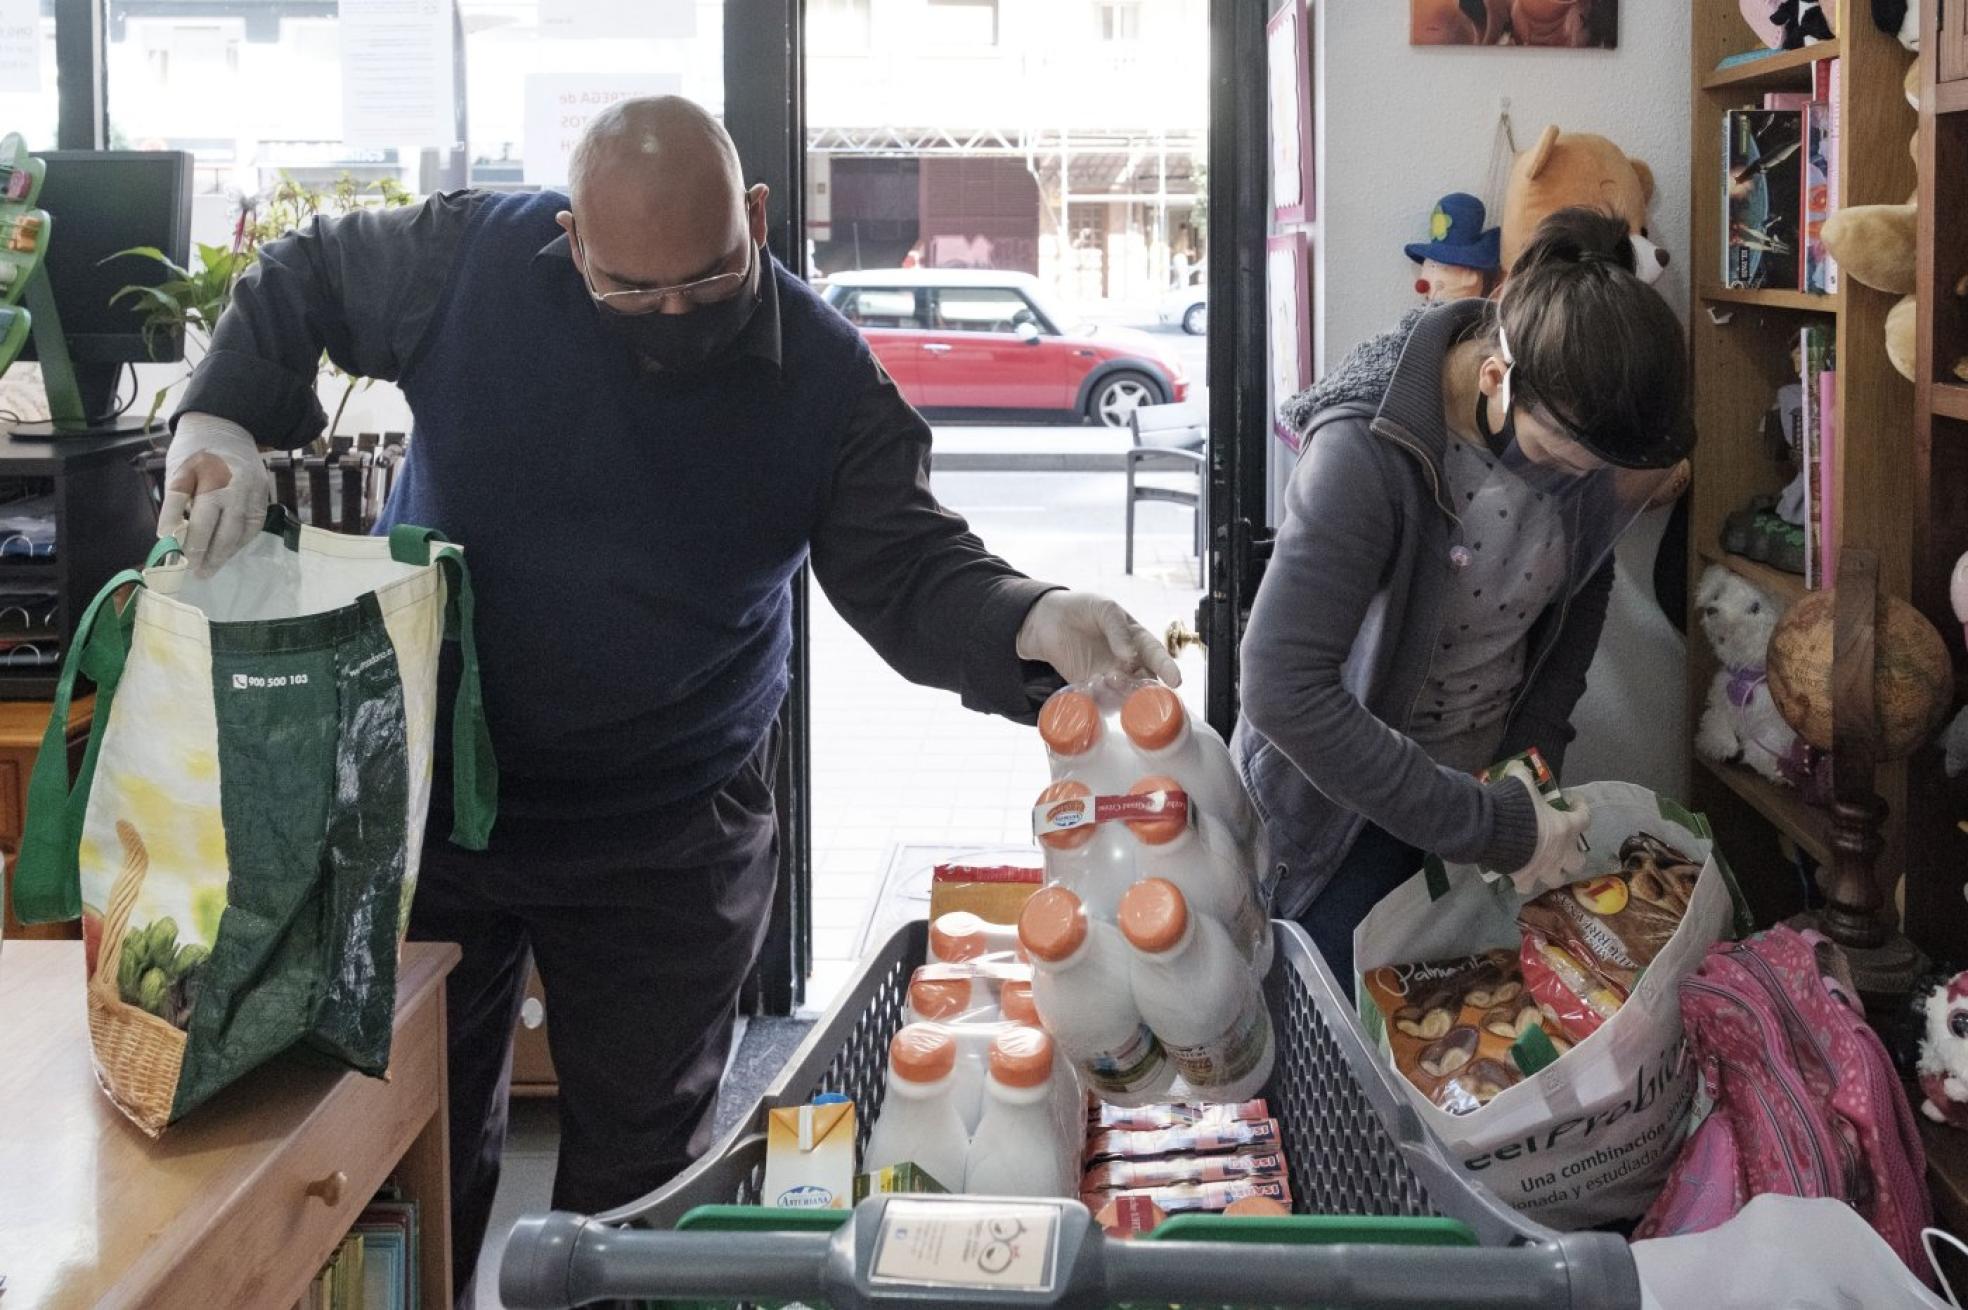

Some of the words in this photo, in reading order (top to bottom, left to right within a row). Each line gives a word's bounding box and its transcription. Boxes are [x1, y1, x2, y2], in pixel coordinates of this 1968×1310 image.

[248, 676, 265, 688] 900
[267, 676, 287, 688] 500
[289, 673, 308, 685] 103
[1520, 1168, 1556, 1193] Una
[1561, 1122, 1665, 1178] combinación
[1572, 1186, 1582, 1201] y
[1585, 1149, 1660, 1192] estudiada
